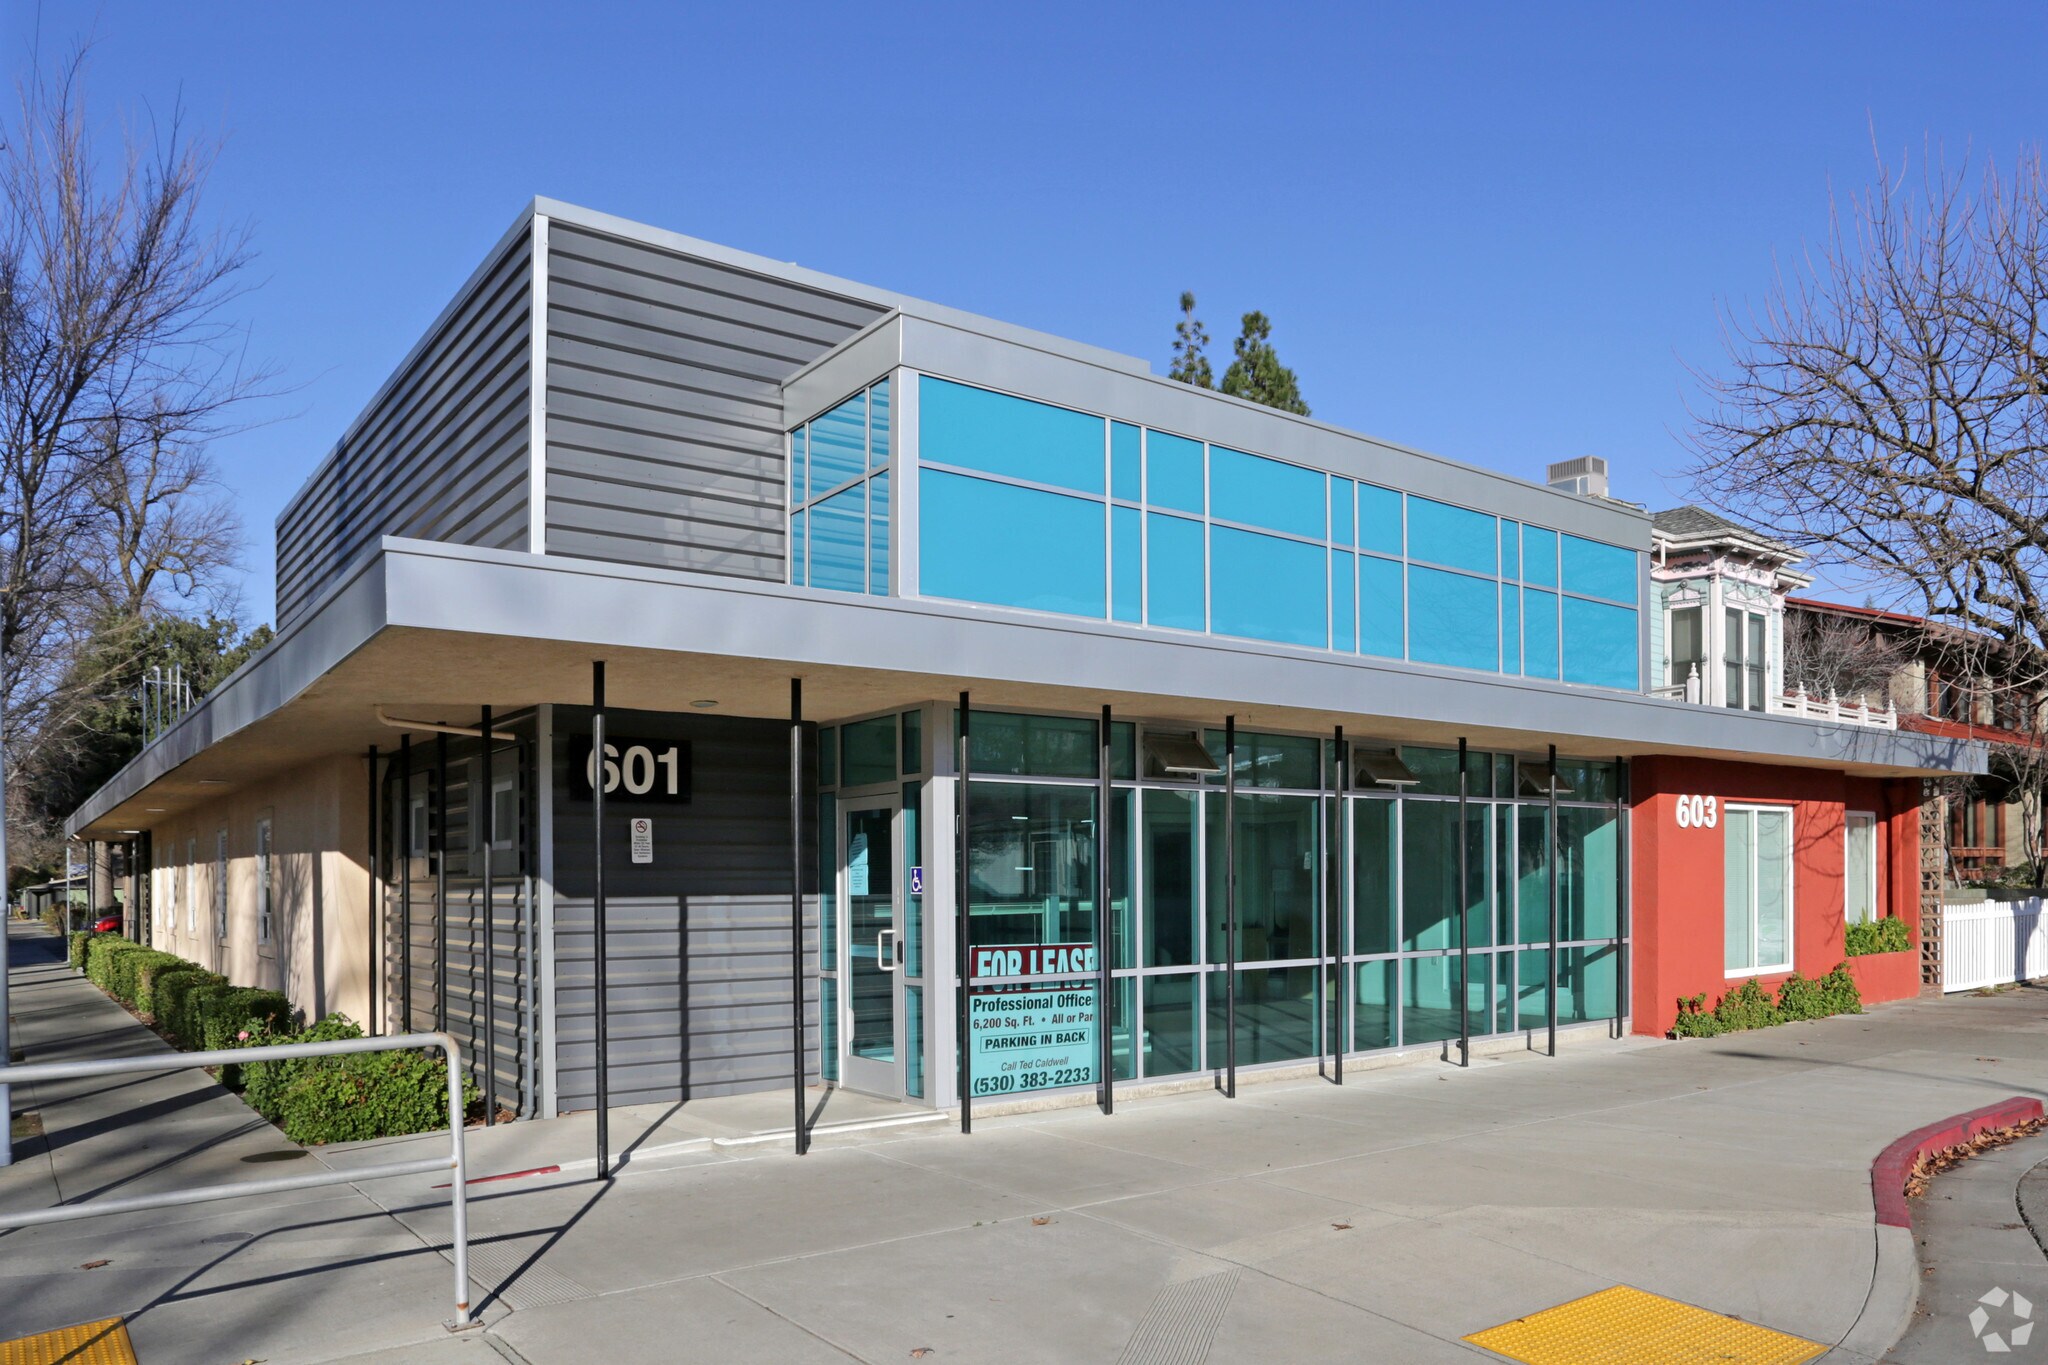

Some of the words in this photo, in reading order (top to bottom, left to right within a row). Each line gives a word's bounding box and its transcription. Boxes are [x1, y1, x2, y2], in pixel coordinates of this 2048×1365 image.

[586, 743, 678, 795] 601
[1676, 794, 1717, 828] 603
[977, 950, 1022, 992] FOR
[973, 995, 1053, 1012] Professional
[1057, 993, 1093, 1008] Office
[973, 1018, 1002, 1031] 6,200
[1004, 1017, 1020, 1029] Sq.
[1023, 1015, 1035, 1026] Ft.
[1051, 1013, 1064, 1024] All
[1066, 1014, 1076, 1023] or
[985, 1035, 1037, 1049] PARKING
[1040, 1034, 1052, 1045] IN
[1056, 1031, 1086, 1043] BACK
[1001, 1061, 1017, 1072] Call
[1019, 1059, 1033, 1070] Ted
[1035, 1056, 1069, 1068] Caldwell
[973, 1075, 1015, 1094] (530)
[1019, 1067, 1090, 1089] 383-2233
